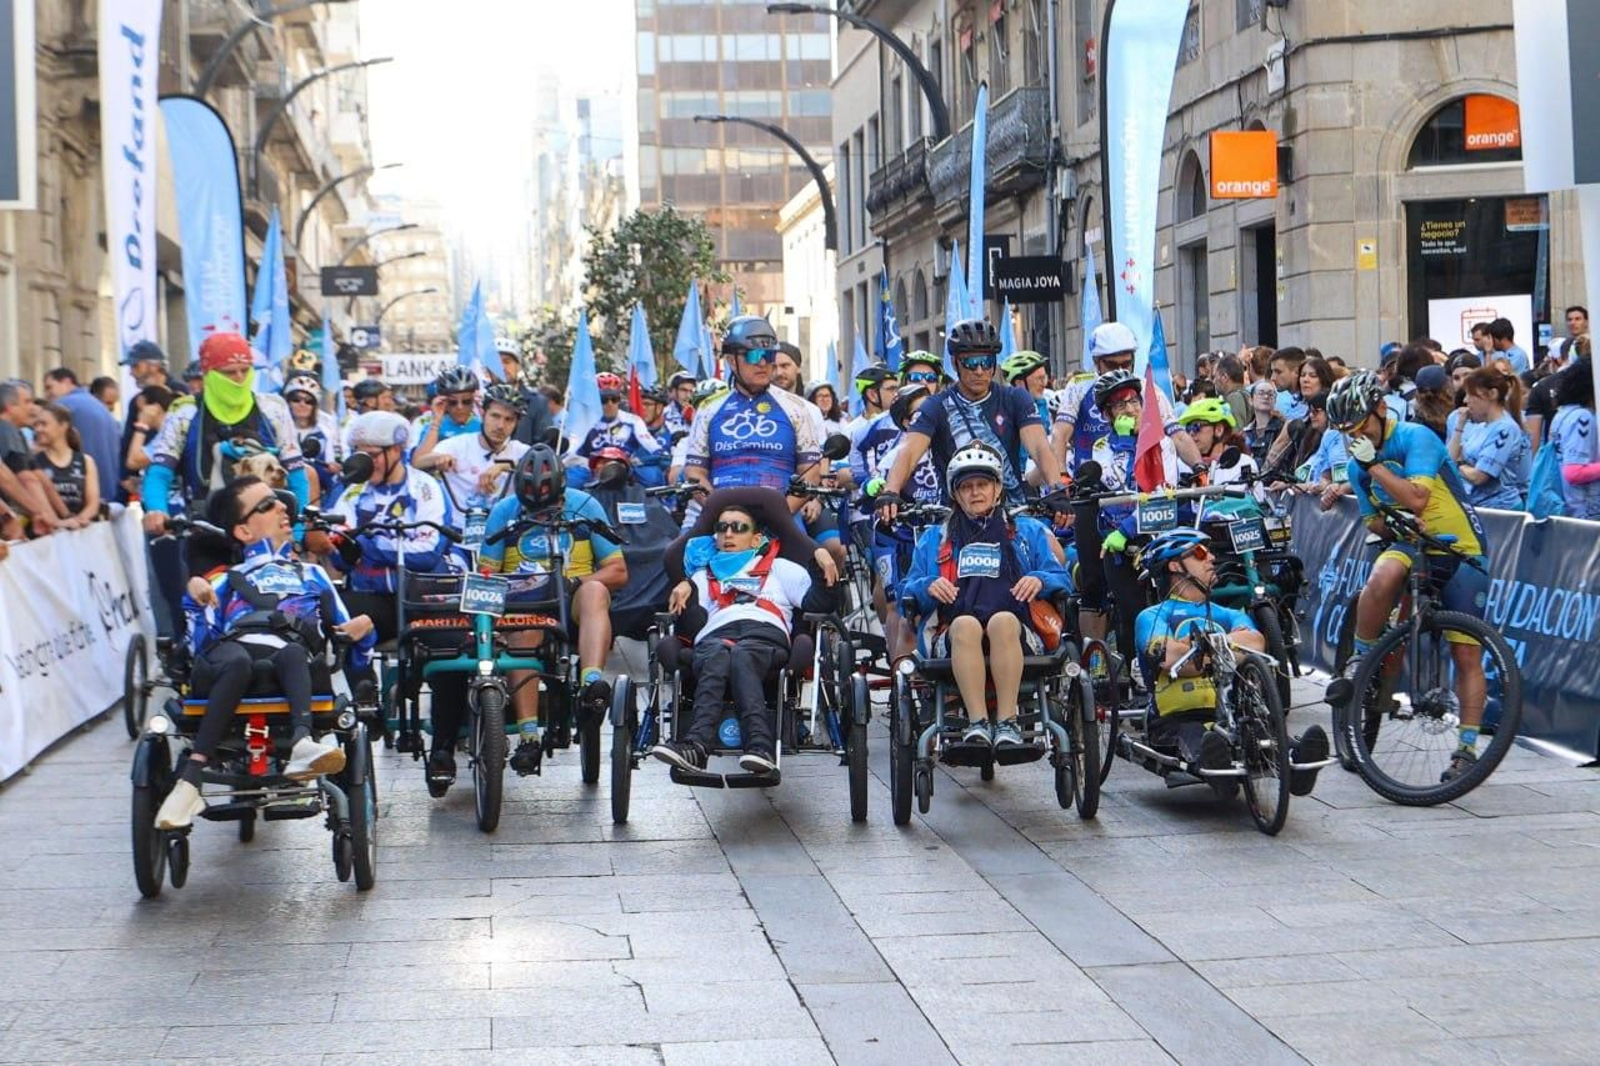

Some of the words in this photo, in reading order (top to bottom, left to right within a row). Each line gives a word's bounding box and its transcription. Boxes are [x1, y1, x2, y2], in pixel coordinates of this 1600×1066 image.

[1467, 131, 1514, 146] orange
[1216, 178, 1272, 196] orange
[1421, 221, 1453, 231] ¿Tienes
[1455, 220, 1466, 229] un
[1421, 229, 1459, 239] negocio?
[999, 277, 1032, 289] MAGIA
[1033, 275, 1061, 288] JOYA
[385, 359, 458, 377] LANKA
[714, 440, 783, 452] DisCamino
[1141, 509, 1175, 522] 10015
[1234, 530, 1261, 543] 10025
[960, 556, 1000, 568] 10008
[411, 616, 470, 629] MARITA
[495, 615, 558, 627] ALONSO
